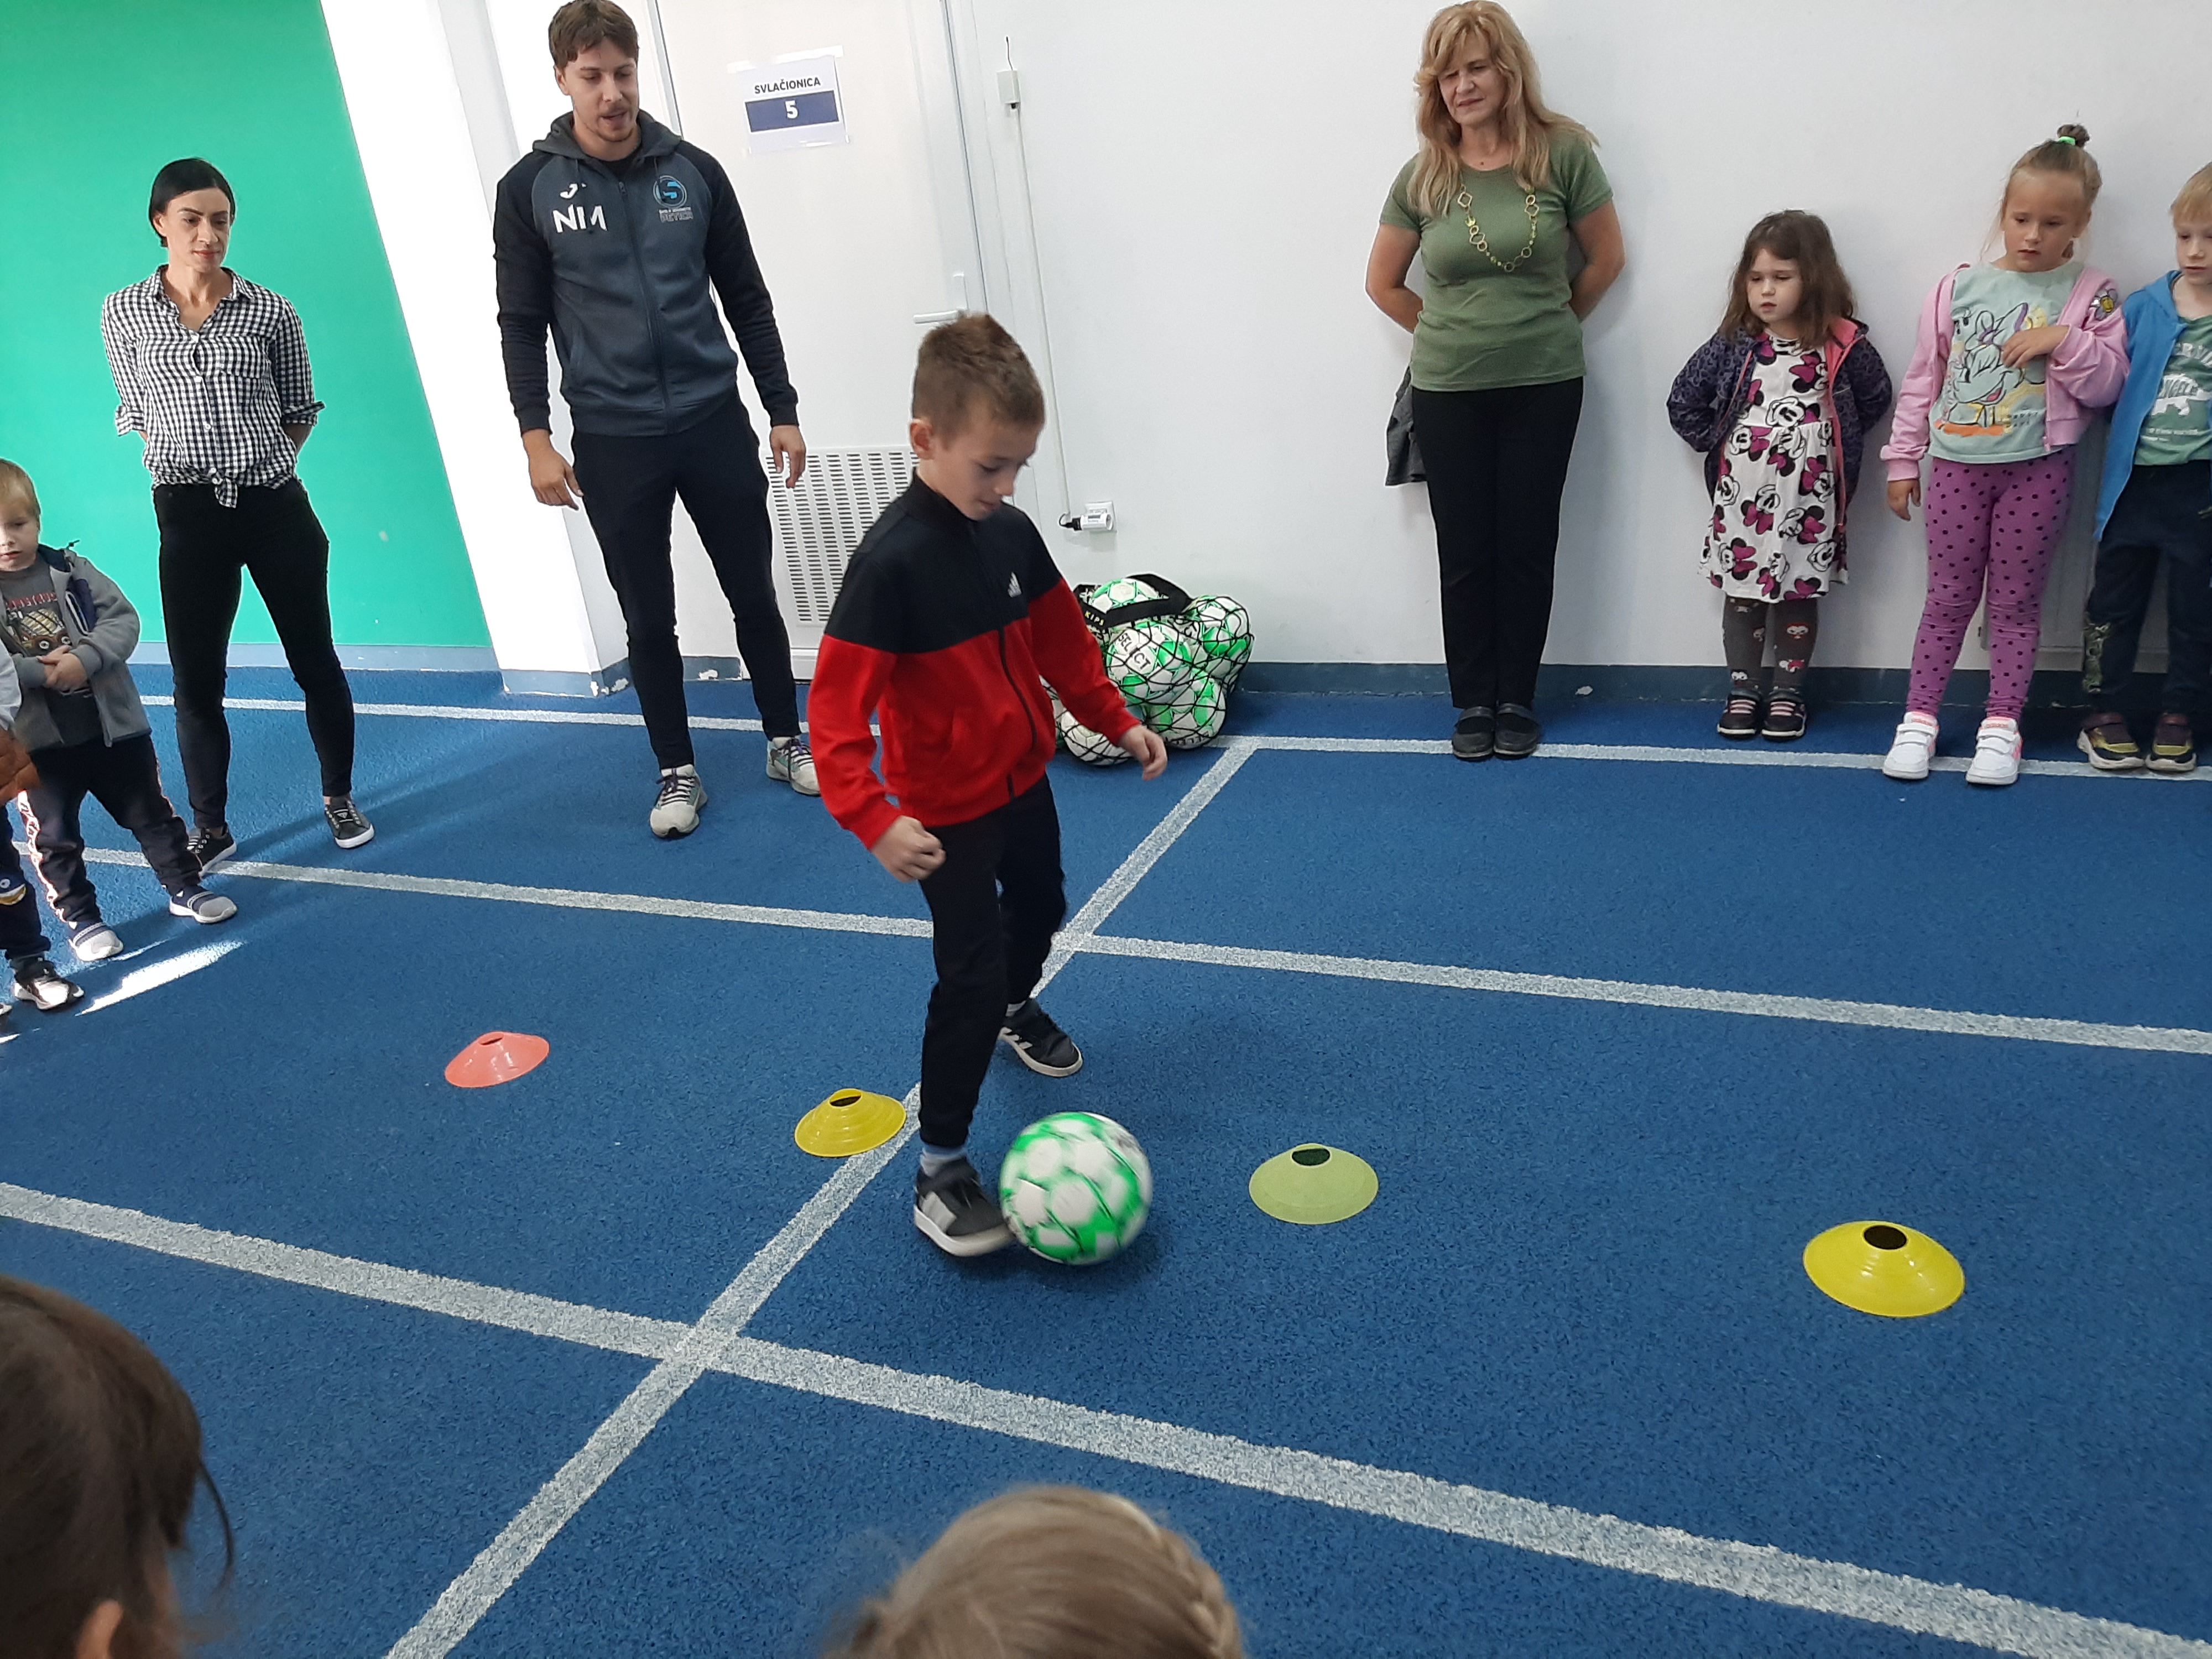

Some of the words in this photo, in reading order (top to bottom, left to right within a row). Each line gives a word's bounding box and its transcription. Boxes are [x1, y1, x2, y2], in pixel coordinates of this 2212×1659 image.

[754, 77, 821, 94] SVLAČIONICA
[785, 100, 799, 119] 5
[1118, 632, 1151, 670] SELCT
